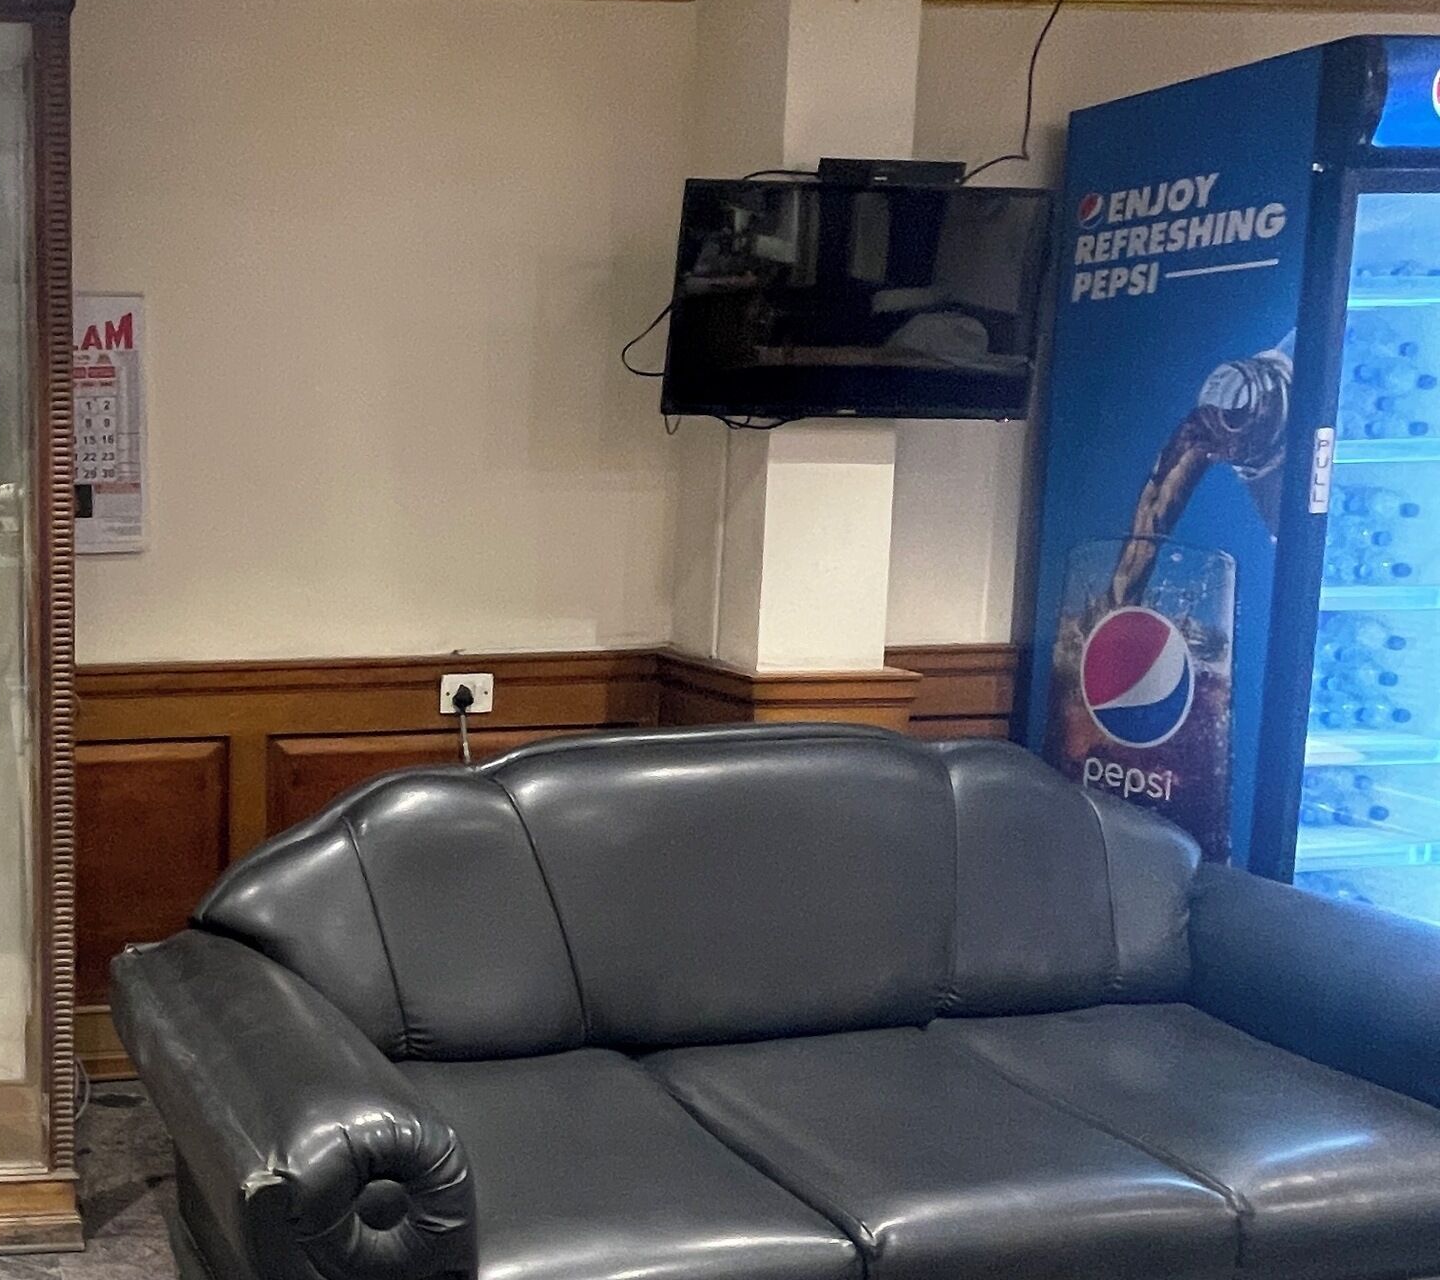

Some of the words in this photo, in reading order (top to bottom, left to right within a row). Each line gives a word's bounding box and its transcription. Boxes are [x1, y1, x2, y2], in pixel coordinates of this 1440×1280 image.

[1107, 172, 1220, 224] ENJOY
[1073, 202, 1287, 265] REFRESHING
[1071, 261, 1159, 303] PEPSI
[82, 452, 97, 462] 22
[1312, 439, 1330, 503] PULL
[1082, 756, 1174, 801] pepsi
